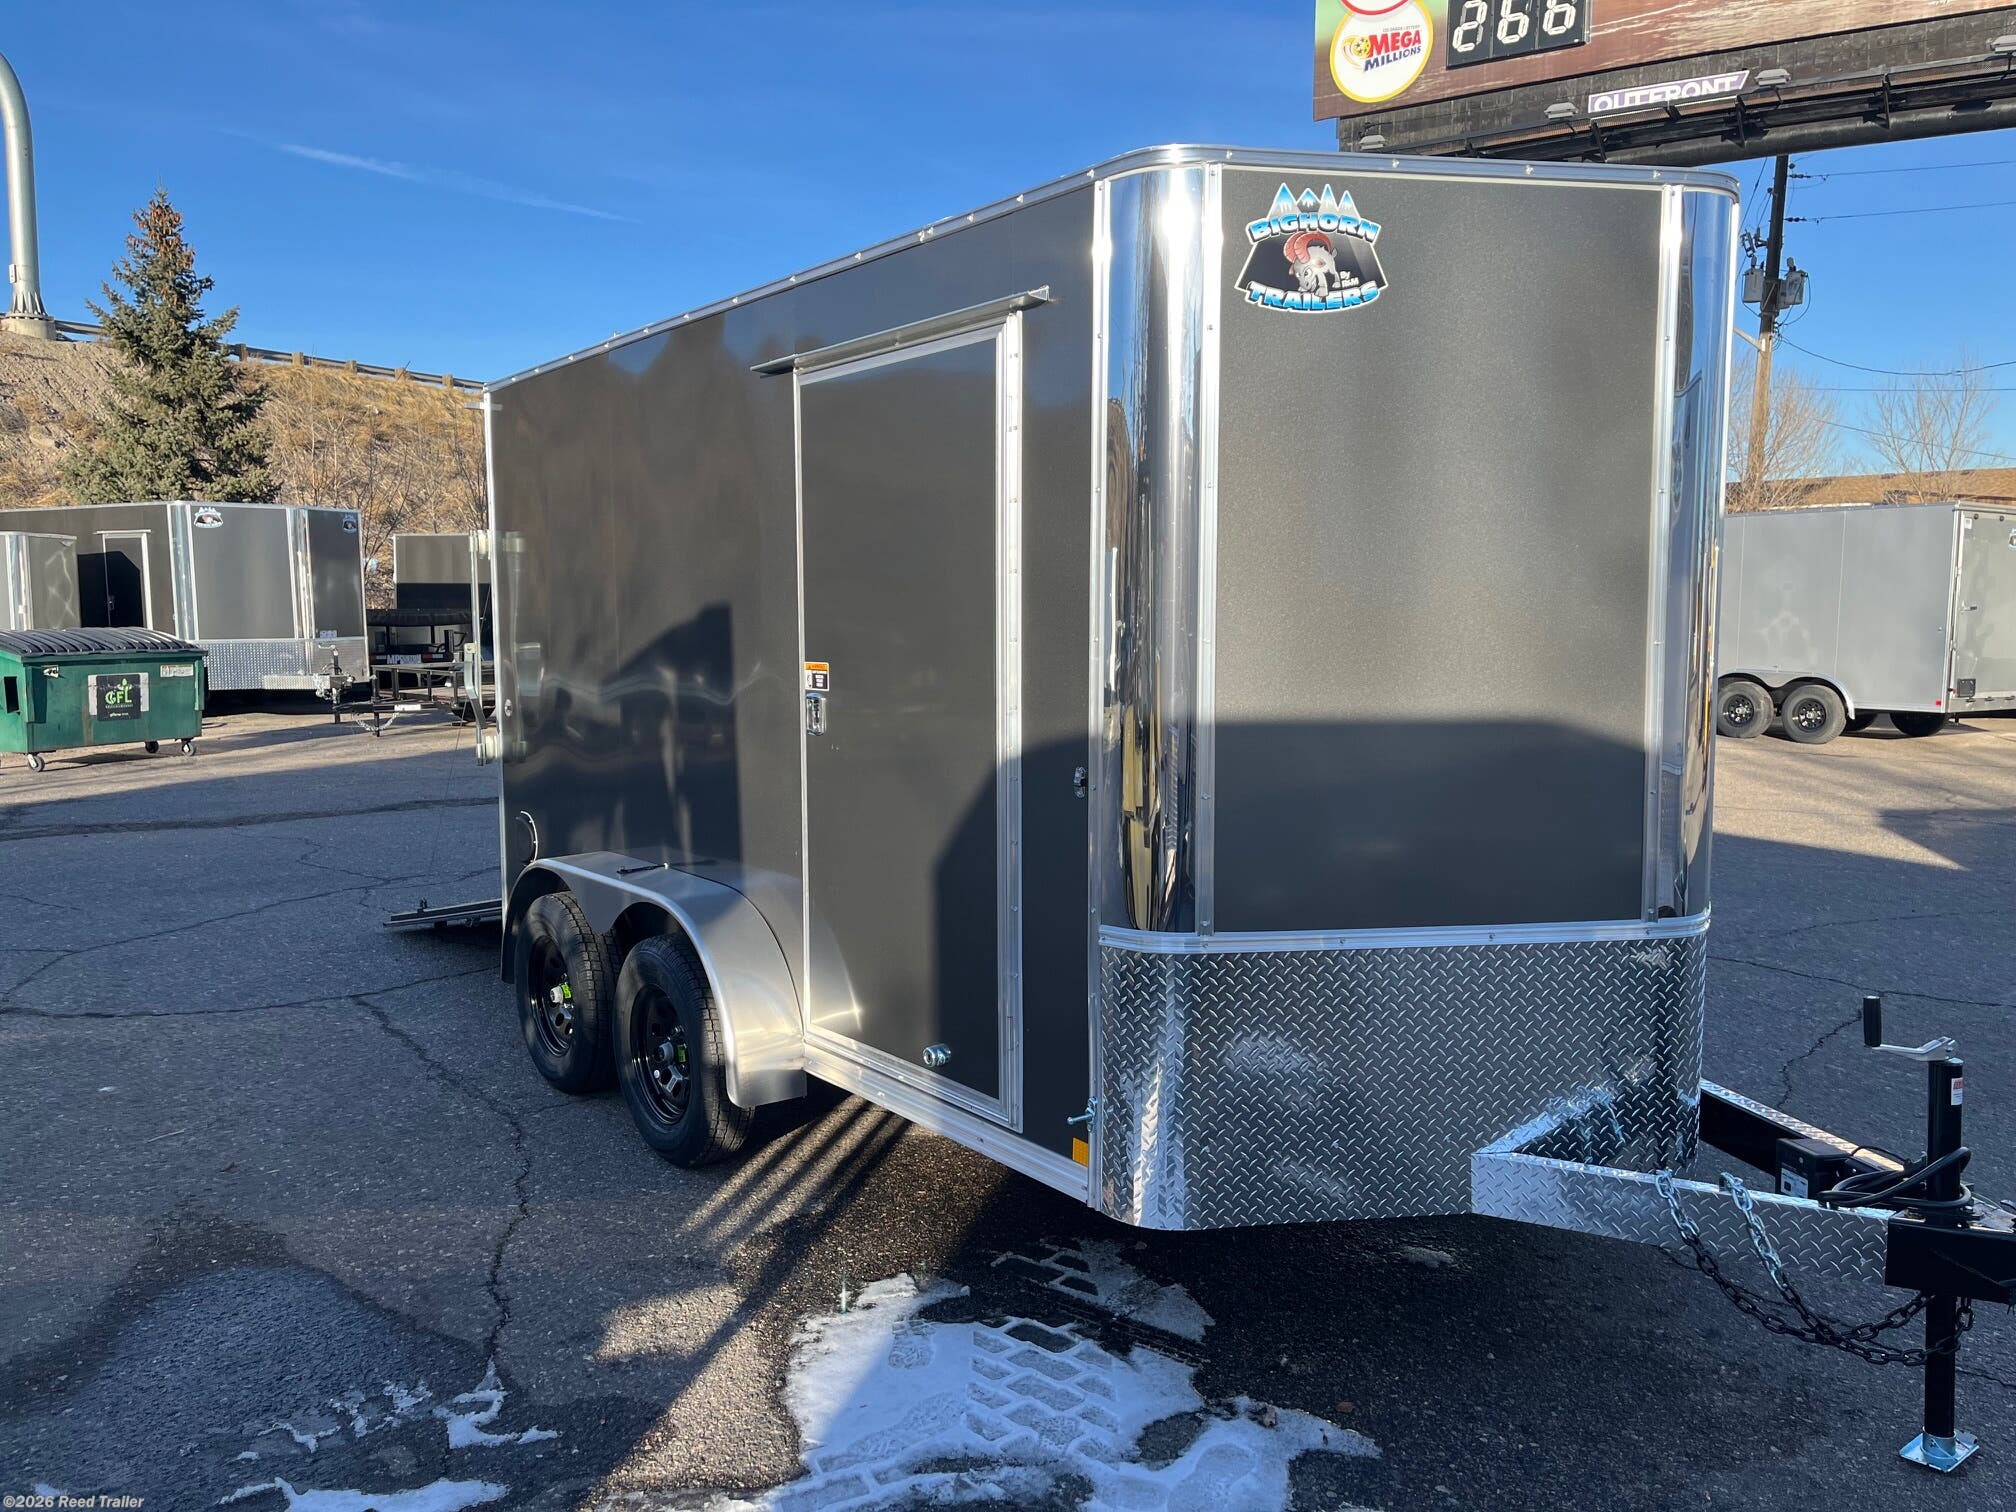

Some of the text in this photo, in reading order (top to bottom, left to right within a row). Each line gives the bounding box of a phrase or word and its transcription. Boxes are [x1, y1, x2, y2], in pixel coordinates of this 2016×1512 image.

[1367, 30, 1422, 58] MEGA
[1363, 46, 1422, 72] MILLIONS
[1249, 213, 1381, 242] BIGHORN
[1247, 280, 1380, 311] TRAILERS
[104, 685, 133, 706] GFL
